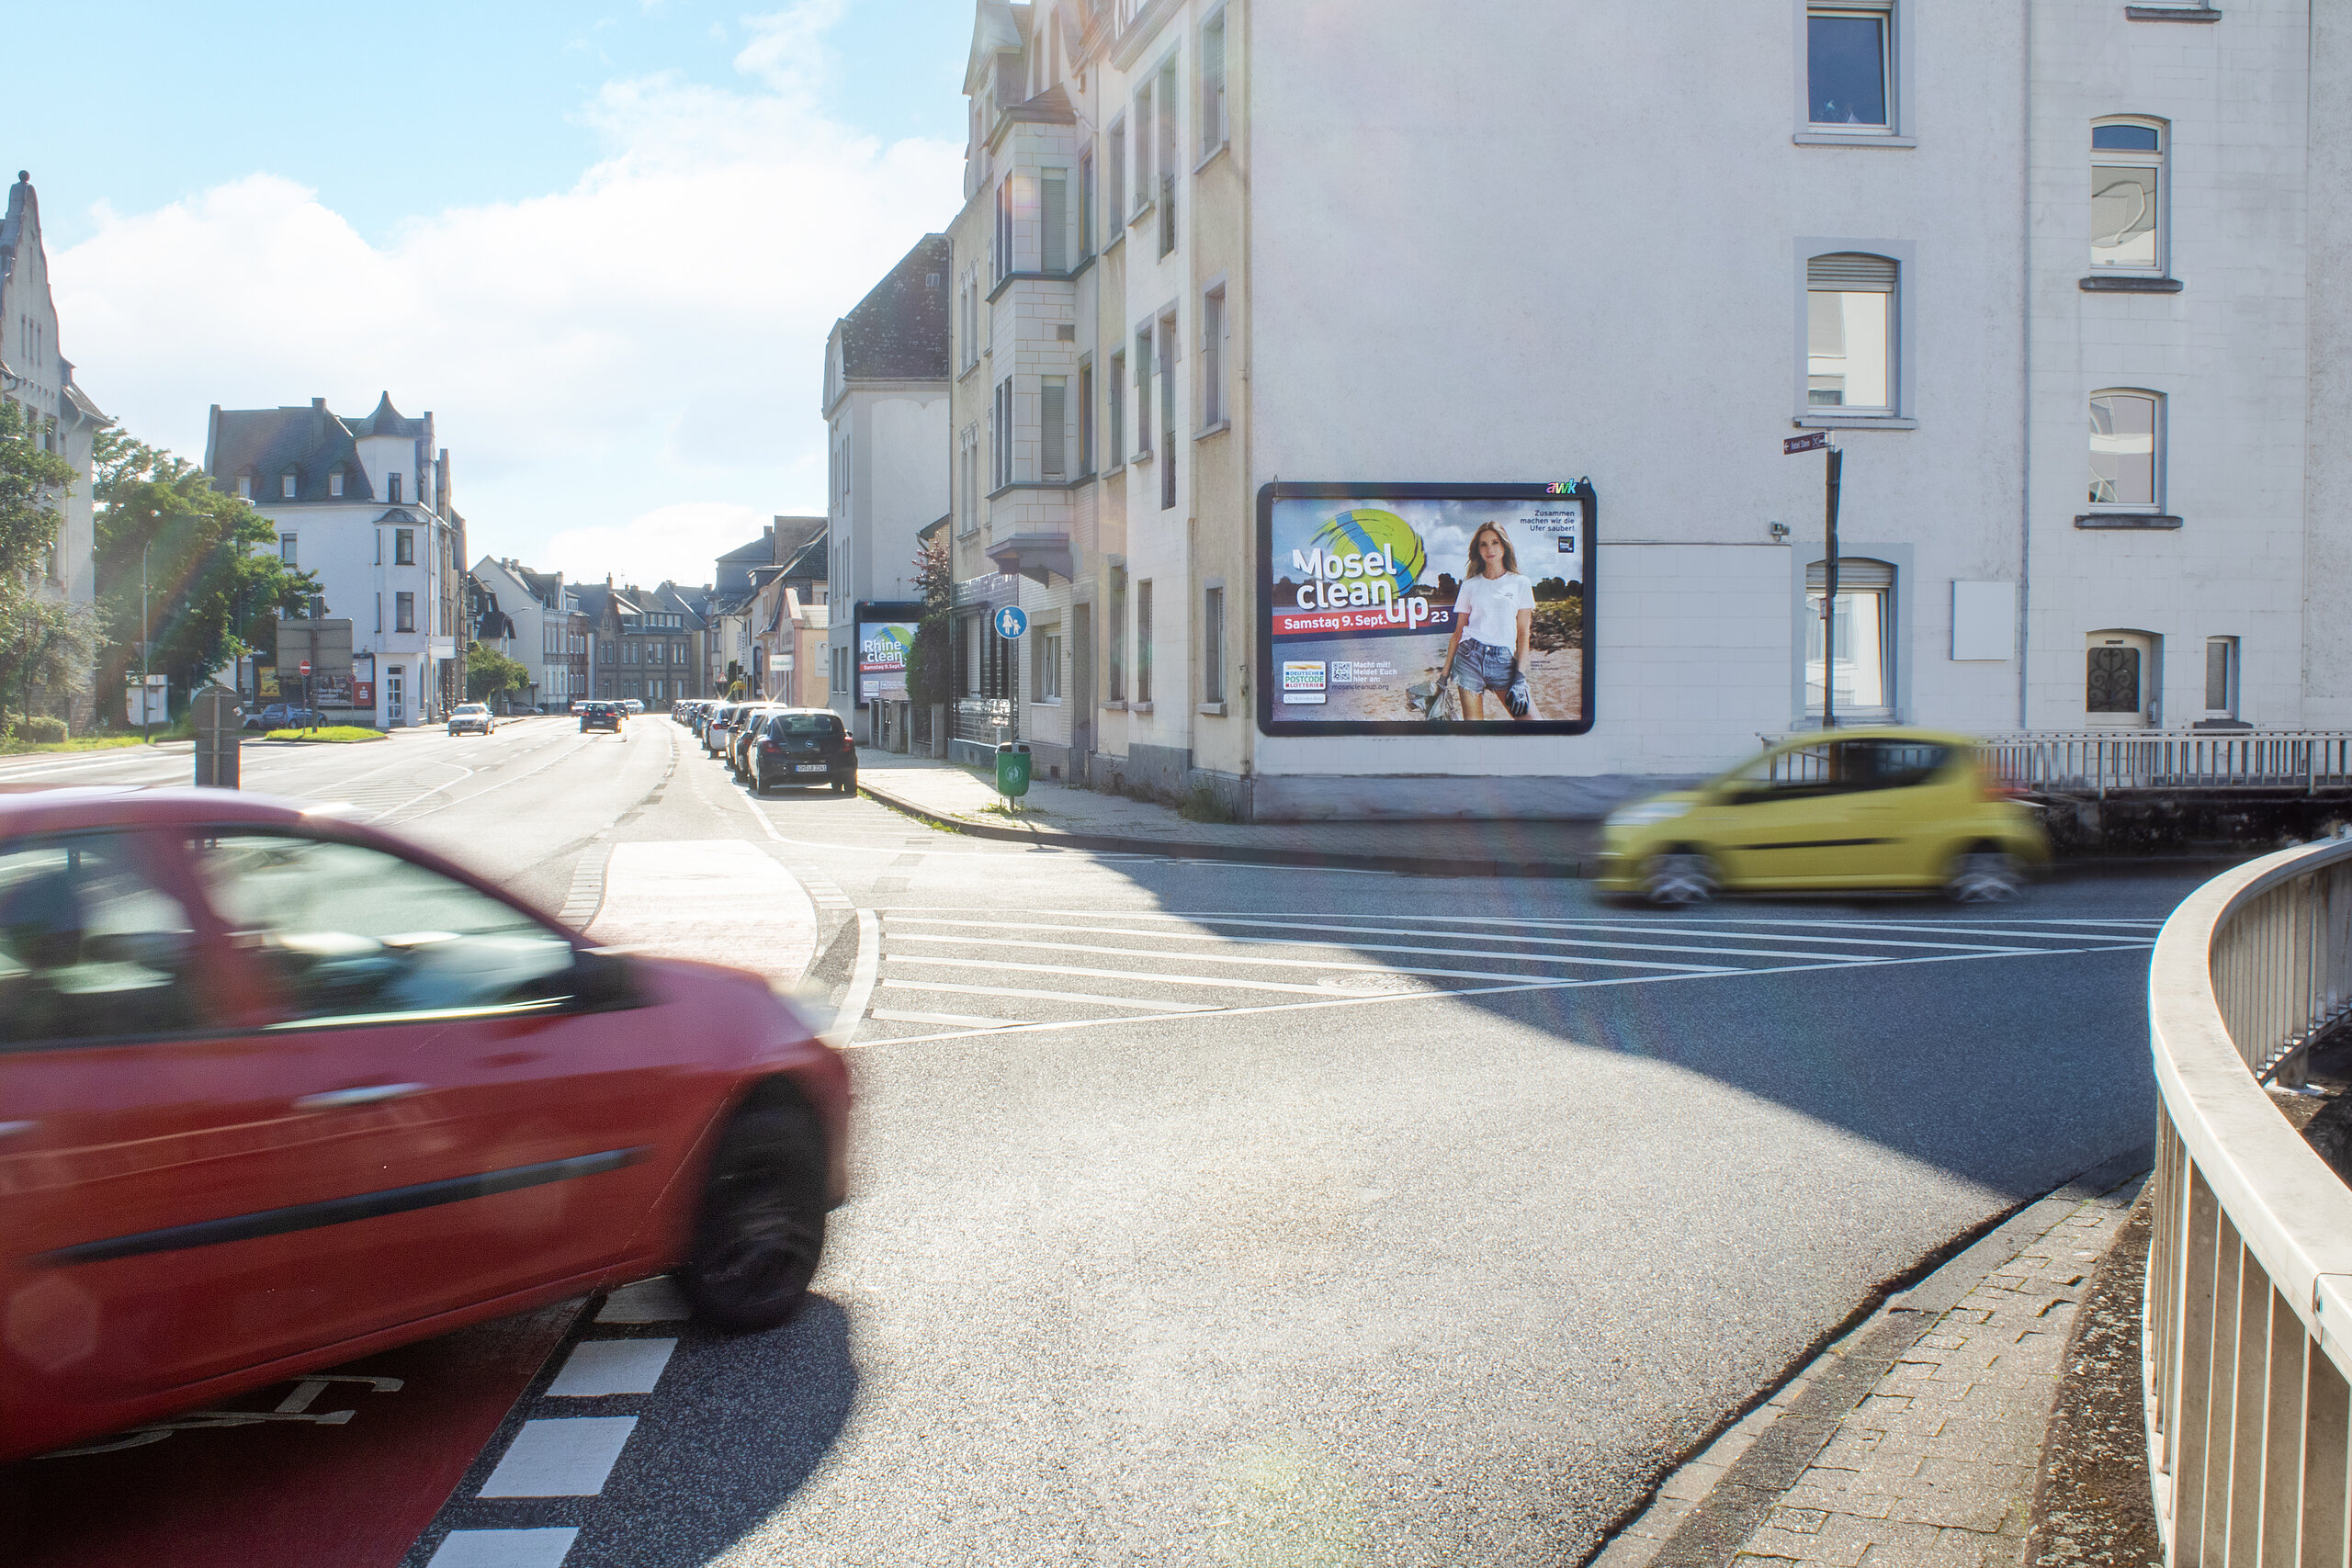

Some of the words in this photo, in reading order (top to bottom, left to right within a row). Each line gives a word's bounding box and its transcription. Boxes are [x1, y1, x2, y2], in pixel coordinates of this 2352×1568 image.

[1546, 479, 1578, 494] awk
[1292, 543, 1397, 581] Mosel
[1296, 579, 1391, 611] clean
[1283, 616, 1340, 630] Samstag
[1342, 617, 1354, 627] 9.
[1355, 615, 1388, 626] Sept.
[1430, 611, 1450, 624] 23
[1385, 596, 1429, 630] up
[864, 639, 902, 653] Rhine
[867, 651, 902, 663] clean
[1285, 675, 1324, 683] POSTCODE
